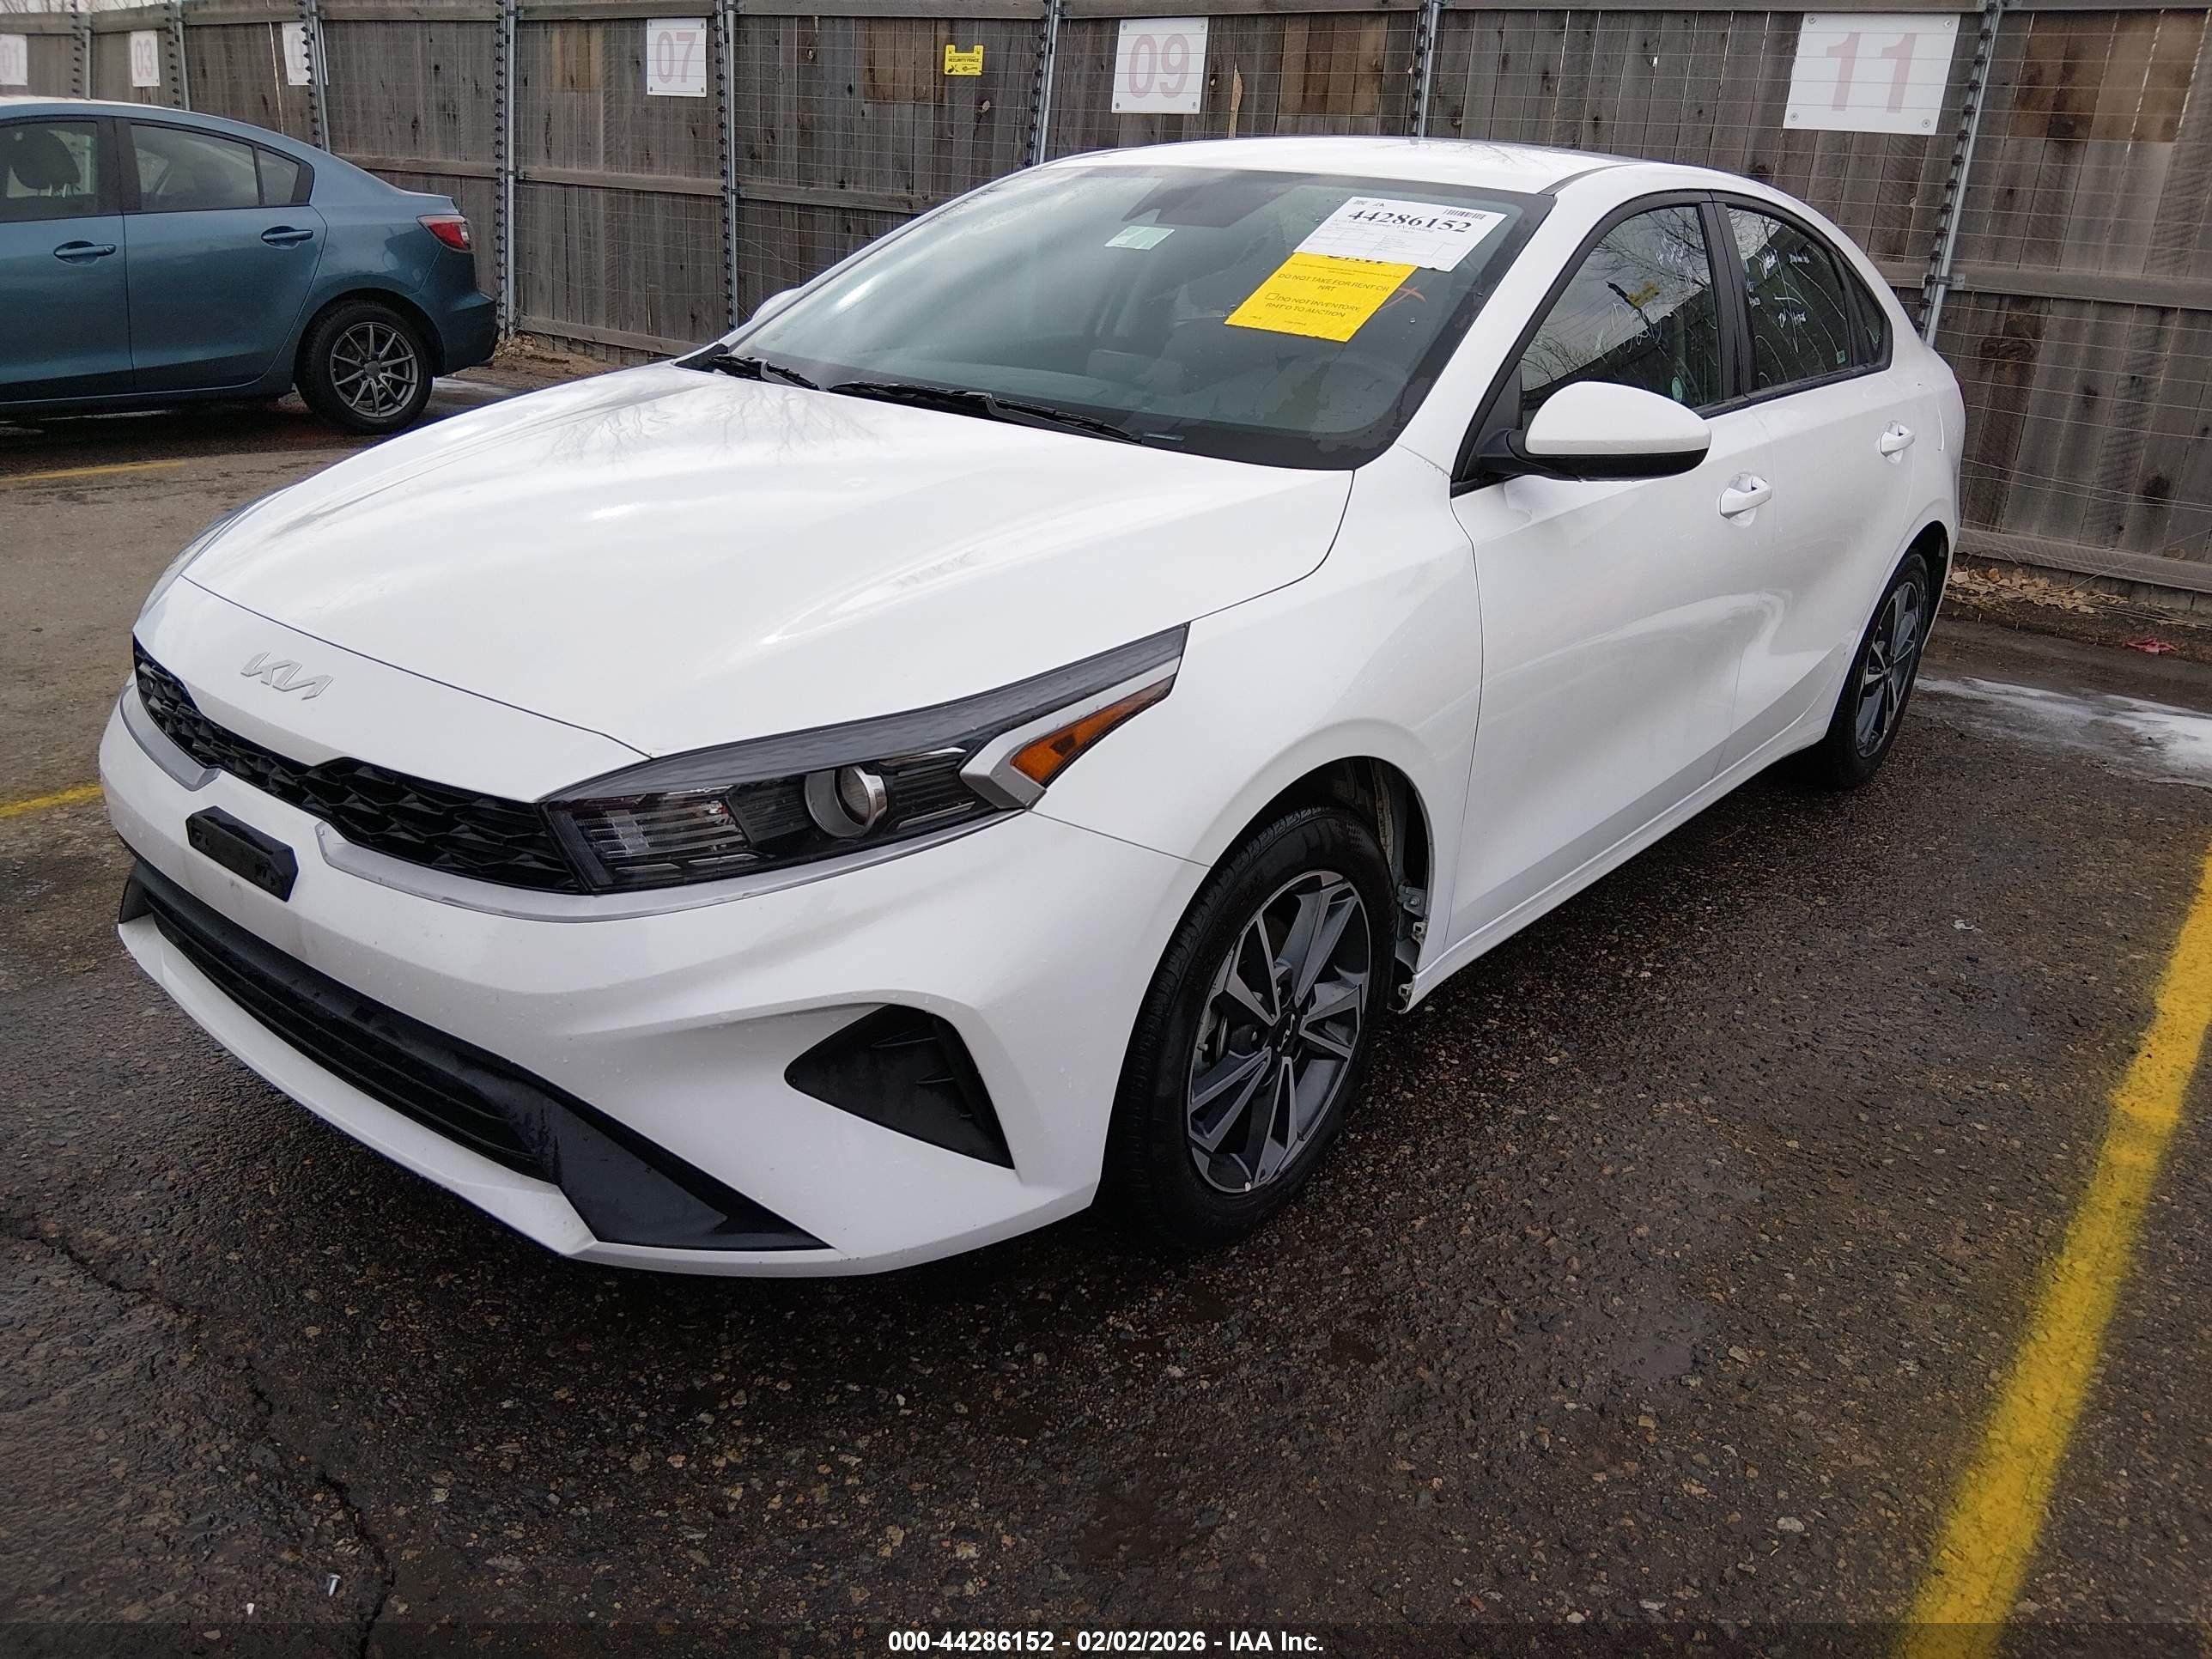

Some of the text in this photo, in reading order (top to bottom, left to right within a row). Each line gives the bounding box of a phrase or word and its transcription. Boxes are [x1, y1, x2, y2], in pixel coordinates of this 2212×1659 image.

[135, 39, 153, 78] 03
[656, 31, 696, 83] 07
[1128, 33, 1190, 99] 09
[1826, 32, 1917, 113] 11
[1347, 210, 1472, 234] 44286152
[1306, 307, 1346, 318] AUCTION
